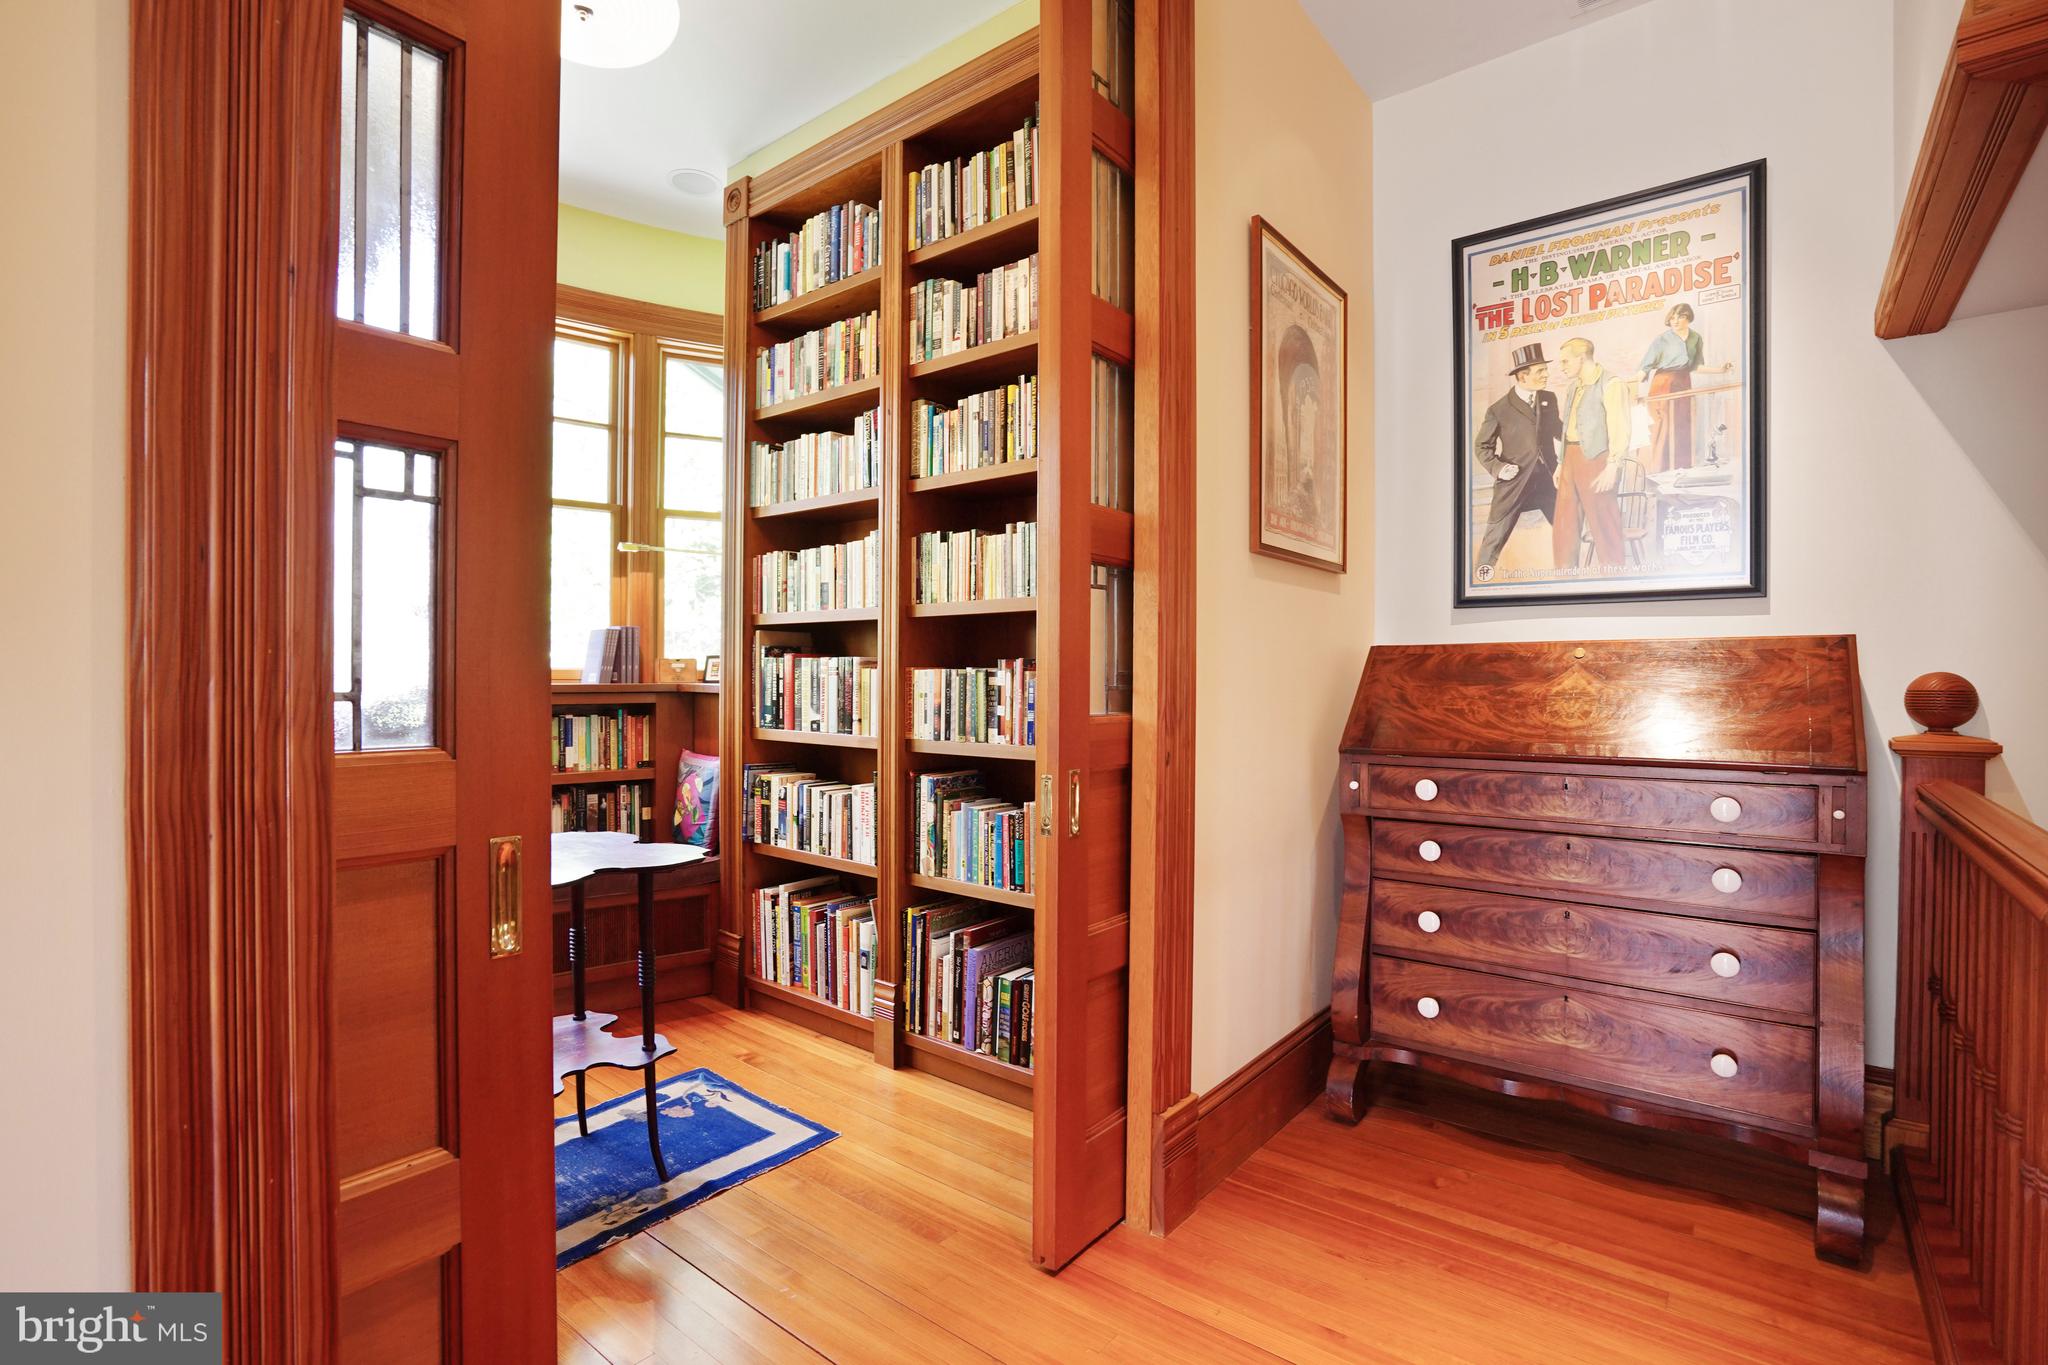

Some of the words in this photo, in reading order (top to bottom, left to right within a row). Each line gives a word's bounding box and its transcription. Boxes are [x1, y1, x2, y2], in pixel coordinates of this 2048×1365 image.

[1489, 244, 1545, 266] DANIEL
[1548, 222, 1635, 253] FROHMAN
[1637, 203, 1721, 232] Presents
[1524, 257, 1538, 265] THE
[1541, 245, 1595, 260] DISTINGUISHED
[1642, 228, 1667, 238] ACTOR
[1567, 231, 1691, 280] WARNER
[1527, 282, 1574, 296] CELEBRATED
[1576, 276, 1603, 286] DRAMA
[1521, 287, 1583, 324] LOST
[1499, 326, 1509, 339] 5
[1665, 524, 1695, 536] FAMOUS
[1695, 521, 1729, 533] PLAYERS
[1680, 535, 1699, 545] FILM
